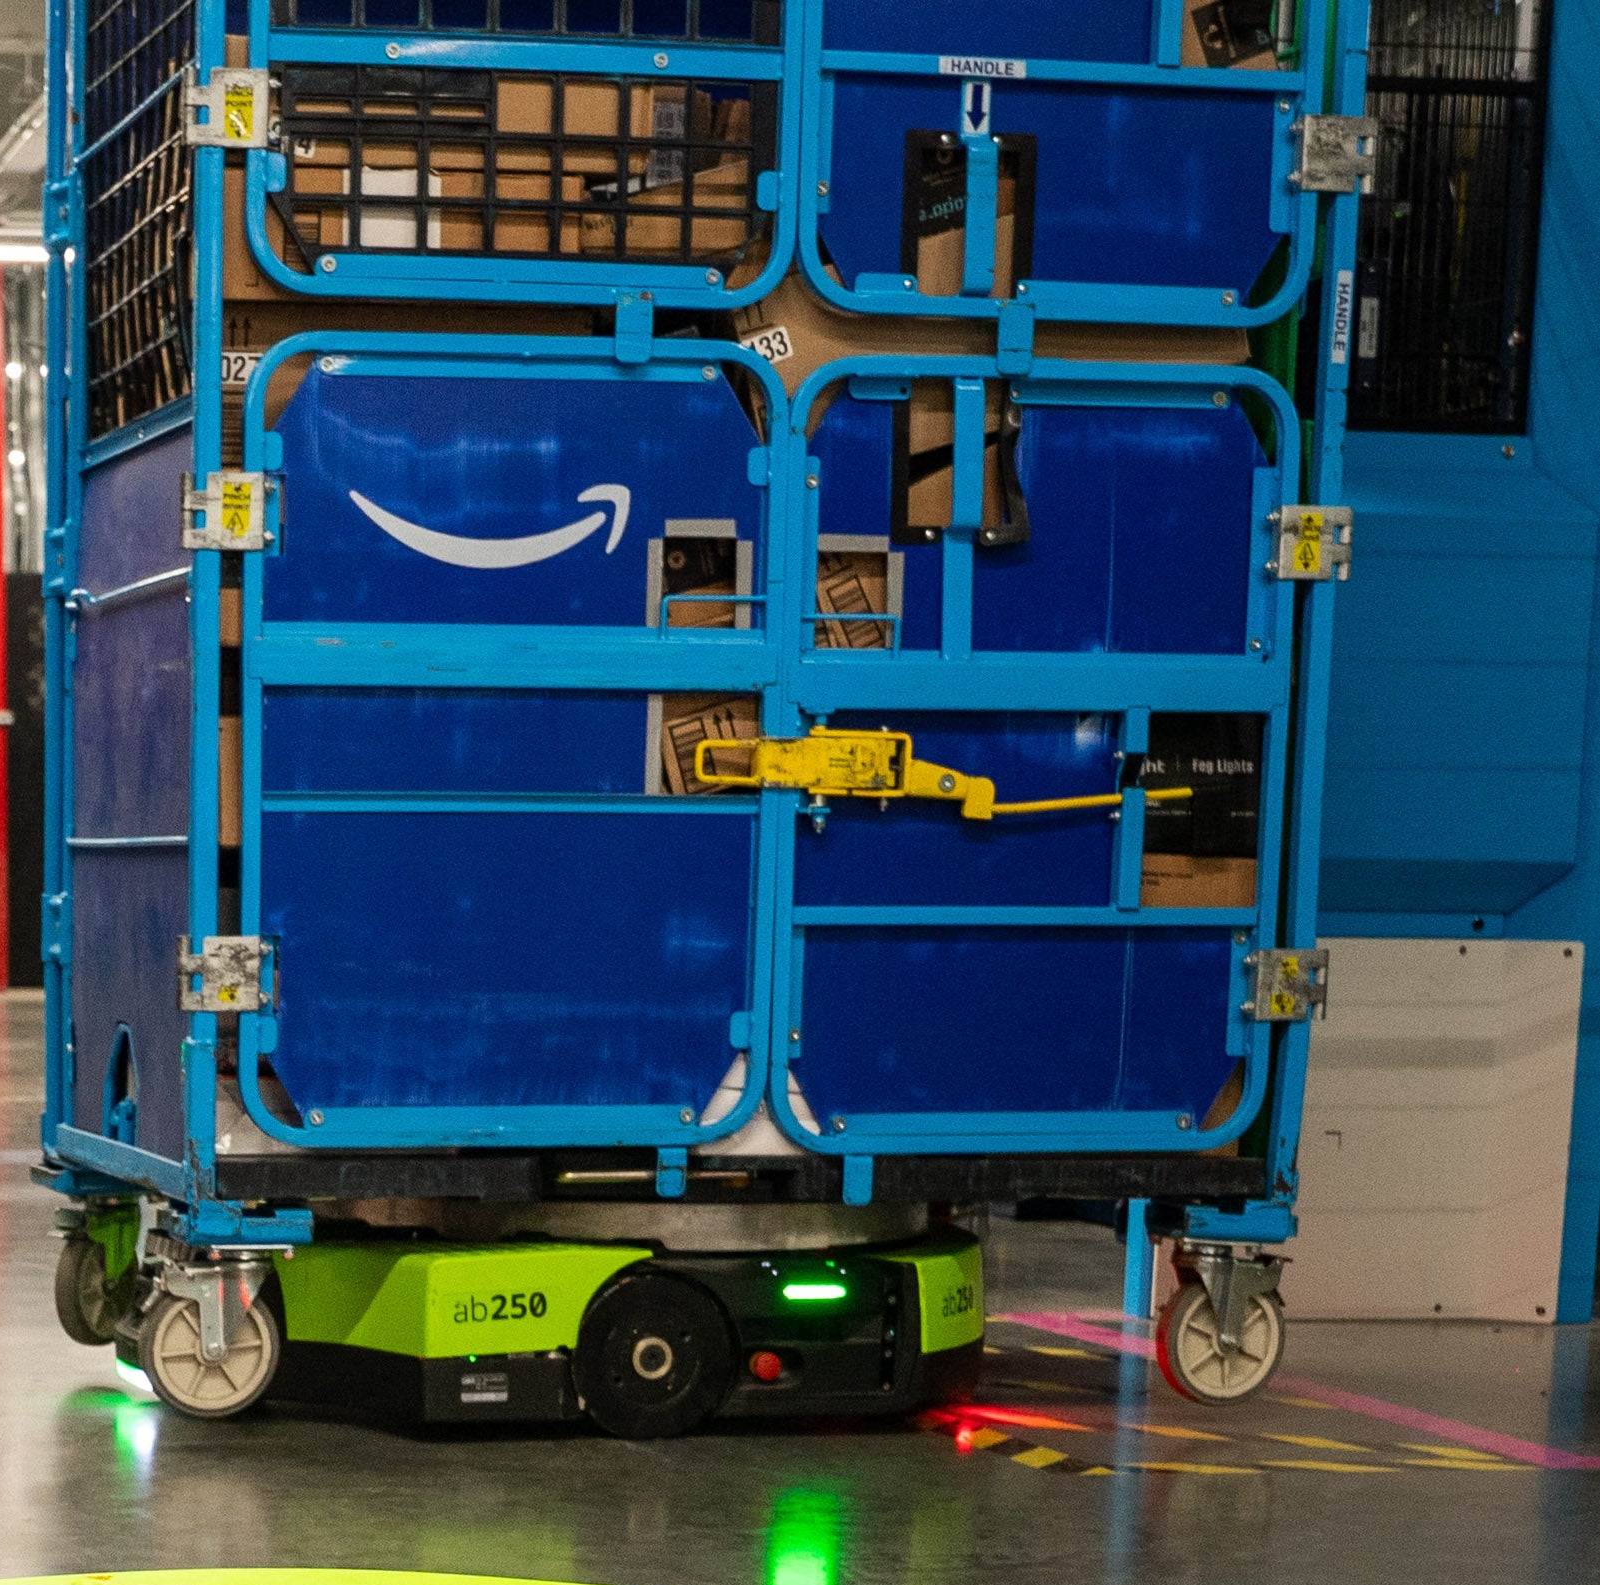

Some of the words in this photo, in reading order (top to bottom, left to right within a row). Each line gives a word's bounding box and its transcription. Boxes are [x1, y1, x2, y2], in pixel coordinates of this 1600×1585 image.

[951, 59, 1015, 76] HANDLE
[1334, 283, 1350, 351] HANDLE
[750, 330, 788, 361] 33
[222, 355, 261, 382] 02
[1192, 758, 1214, 775] Fog
[1217, 758, 1254, 775] Lights
[454, 1291, 547, 1323] ab250
